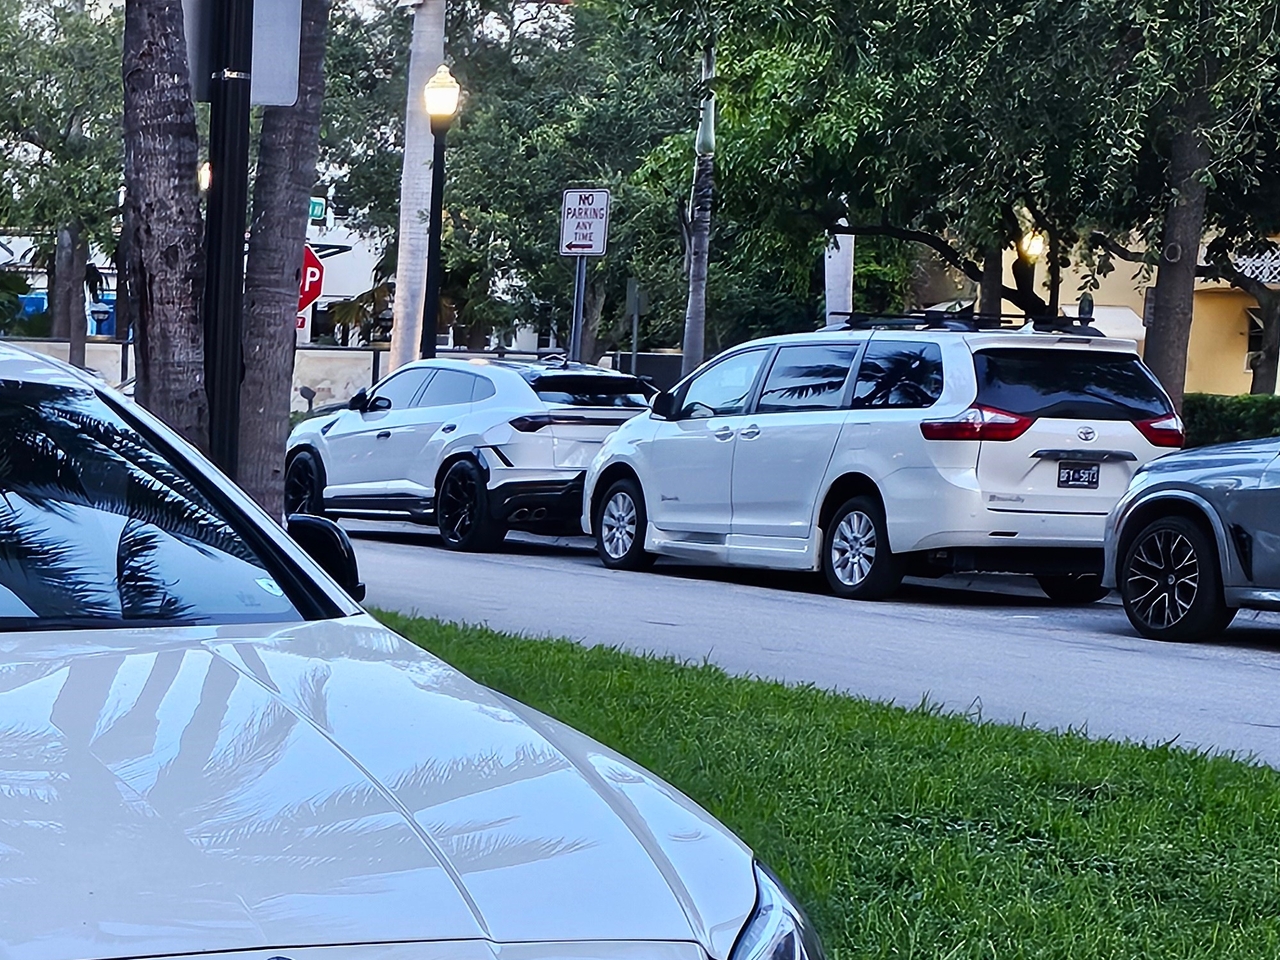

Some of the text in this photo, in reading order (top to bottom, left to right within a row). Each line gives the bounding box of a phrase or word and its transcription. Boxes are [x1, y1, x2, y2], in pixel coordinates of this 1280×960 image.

[578, 193, 595, 206] NO
[566, 207, 605, 220] PARKING
[575, 221, 594, 231] ANY
[574, 231, 594, 242] TIME
